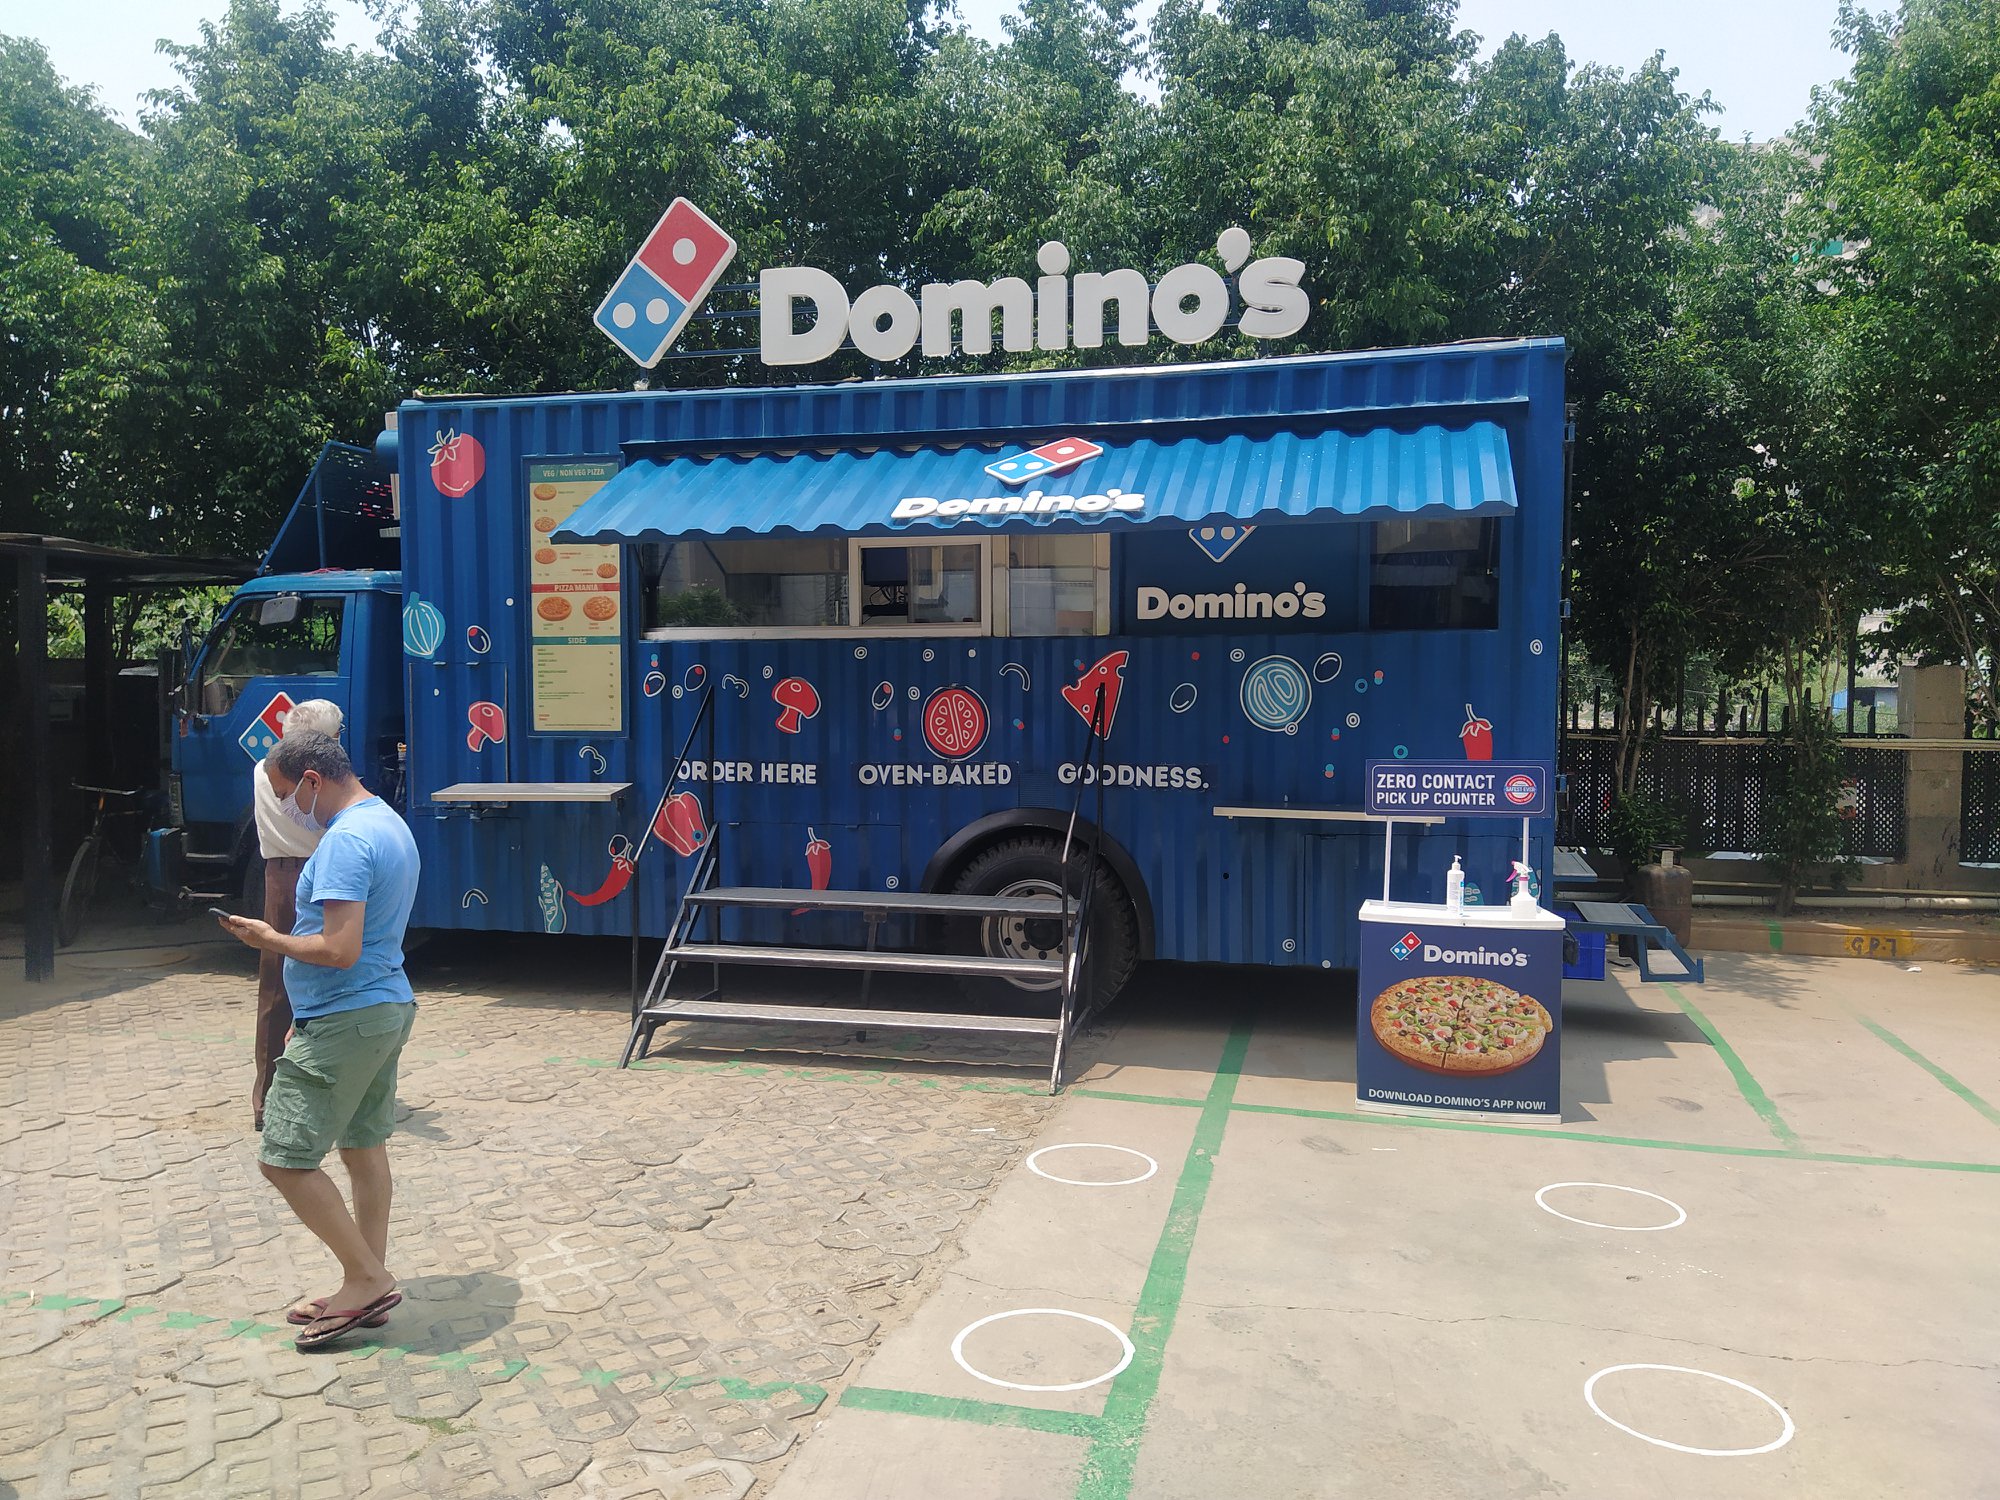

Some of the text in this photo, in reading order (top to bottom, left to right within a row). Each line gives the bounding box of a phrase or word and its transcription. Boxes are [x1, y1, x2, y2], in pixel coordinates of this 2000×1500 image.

[760, 228, 1310, 366] Domino's
[891, 488, 1145, 519] Domino's
[1137, 581, 1326, 620] Domino's
[677, 760, 1210, 789] ORDER HERE OVEN-BAKED GOODNESS.
[1376, 773, 1416, 789] ZERO
[1422, 774, 1496, 790] CONTACT
[1376, 792, 1407, 804] PICK
[1411, 792, 1429, 804] UP
[1433, 792, 1496, 806] COUNTER
[1424, 944, 1528, 967] Domino's
[1368, 1088, 1546, 1110] DOWNLOAD DOMINO'S APP NOW!
